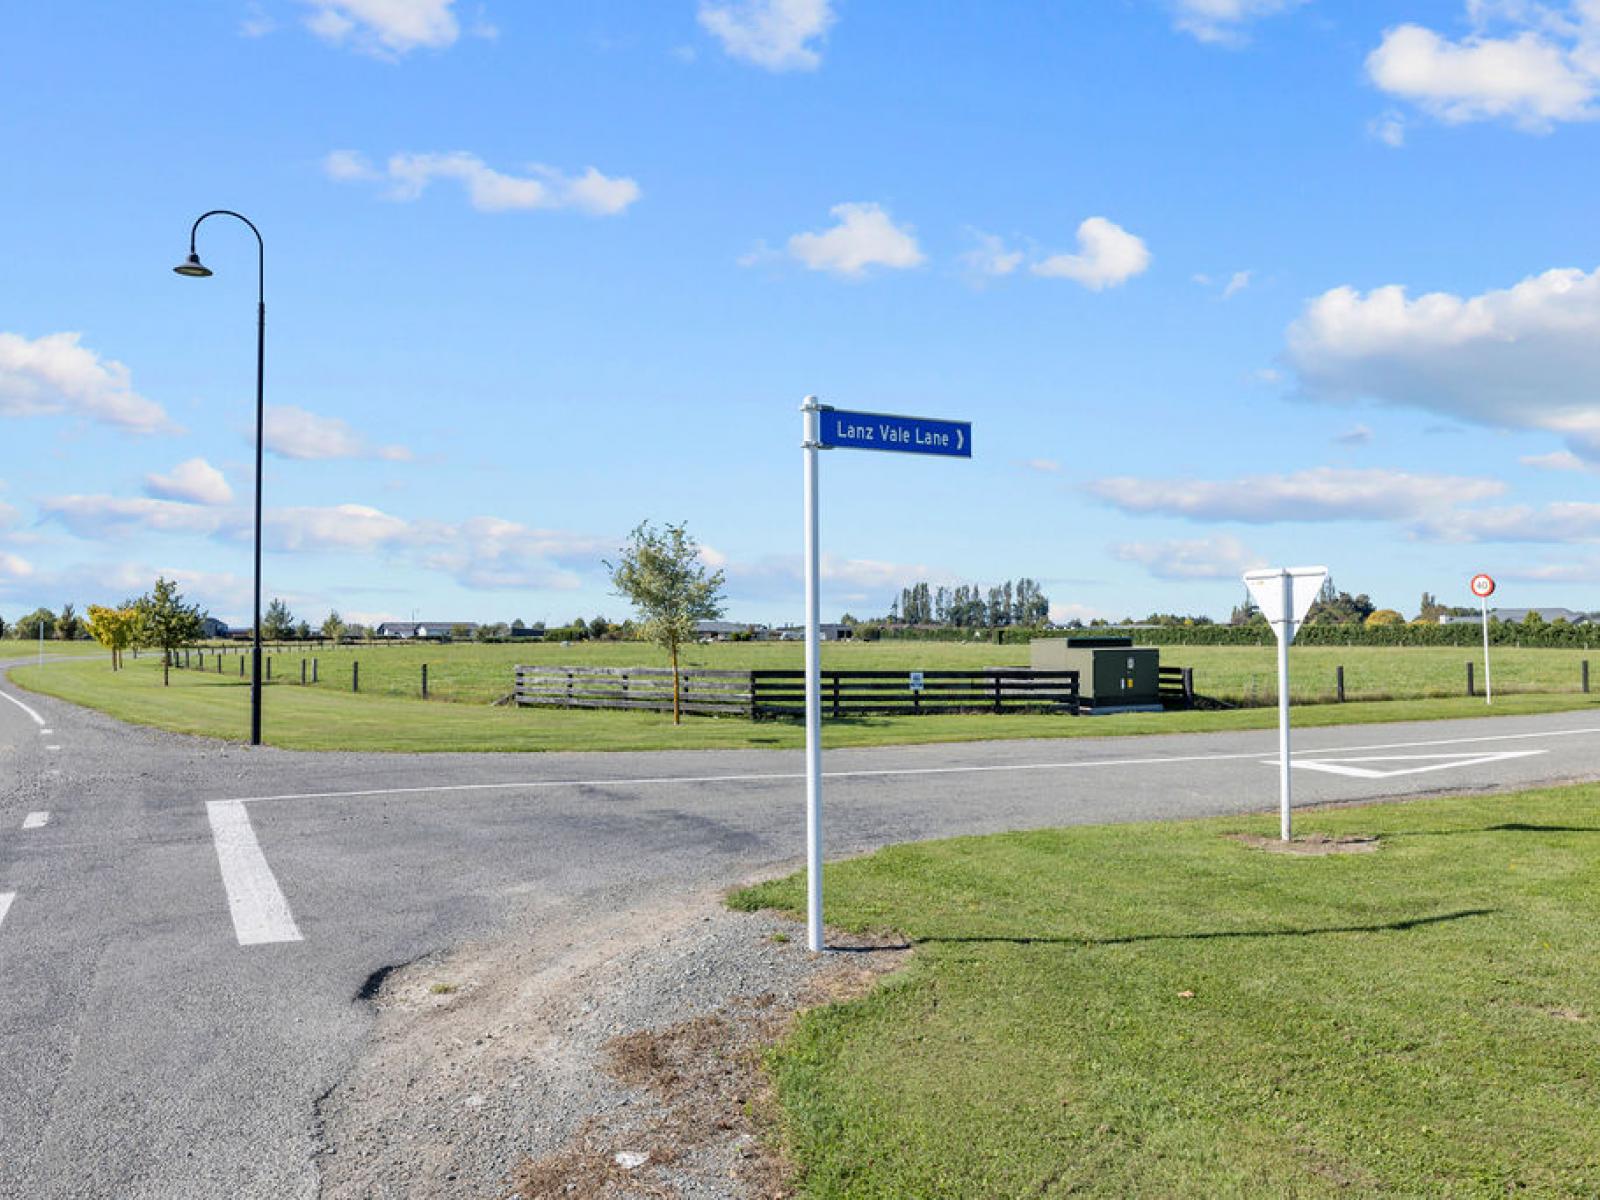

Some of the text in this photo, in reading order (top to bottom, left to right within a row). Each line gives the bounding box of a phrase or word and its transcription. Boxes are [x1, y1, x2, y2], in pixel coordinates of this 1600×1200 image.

[836, 420, 949, 446] Lanz Vale Lane
[1476, 581, 1488, 590] 40
